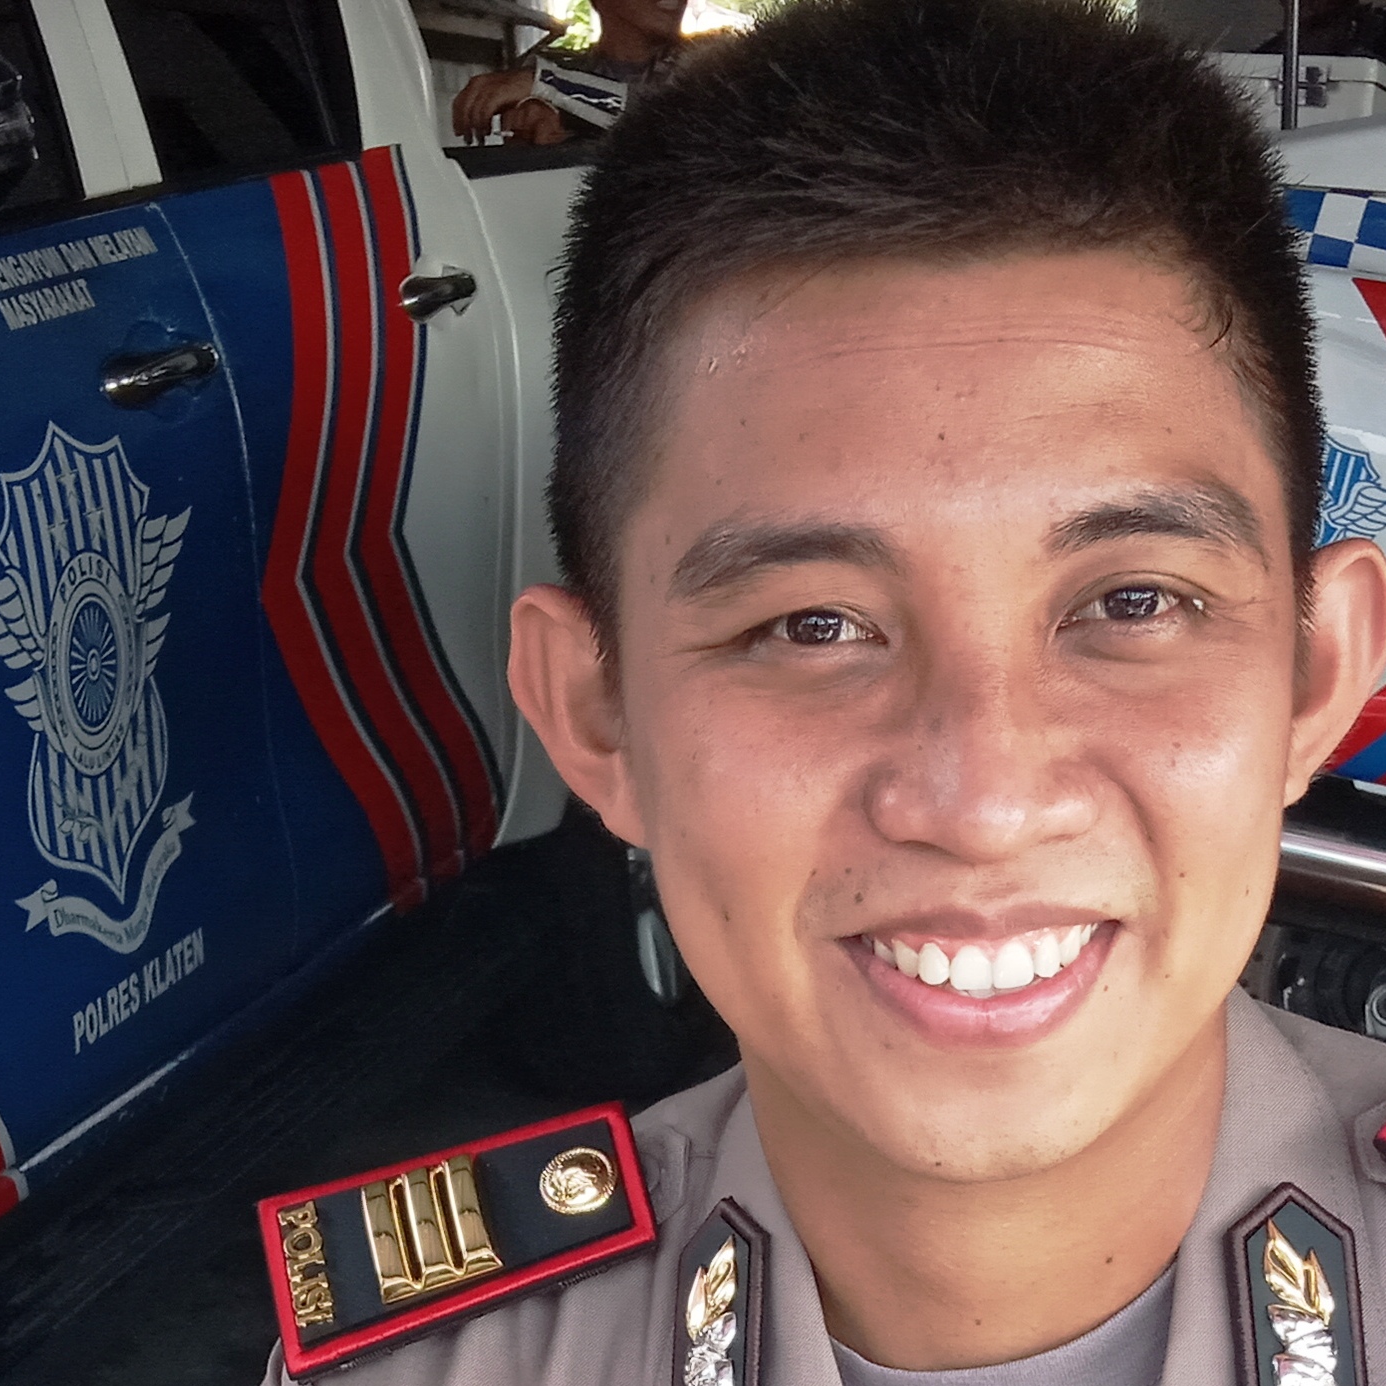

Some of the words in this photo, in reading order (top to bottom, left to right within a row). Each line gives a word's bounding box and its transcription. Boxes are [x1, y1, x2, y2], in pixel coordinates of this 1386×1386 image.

[58, 238, 100, 272] DAN
[60, 555, 112, 603] POLISI
[72, 971, 141, 1055] POLRES
[143, 926, 206, 1003] KLATEN
[276, 1199, 335, 1329] POLISI
